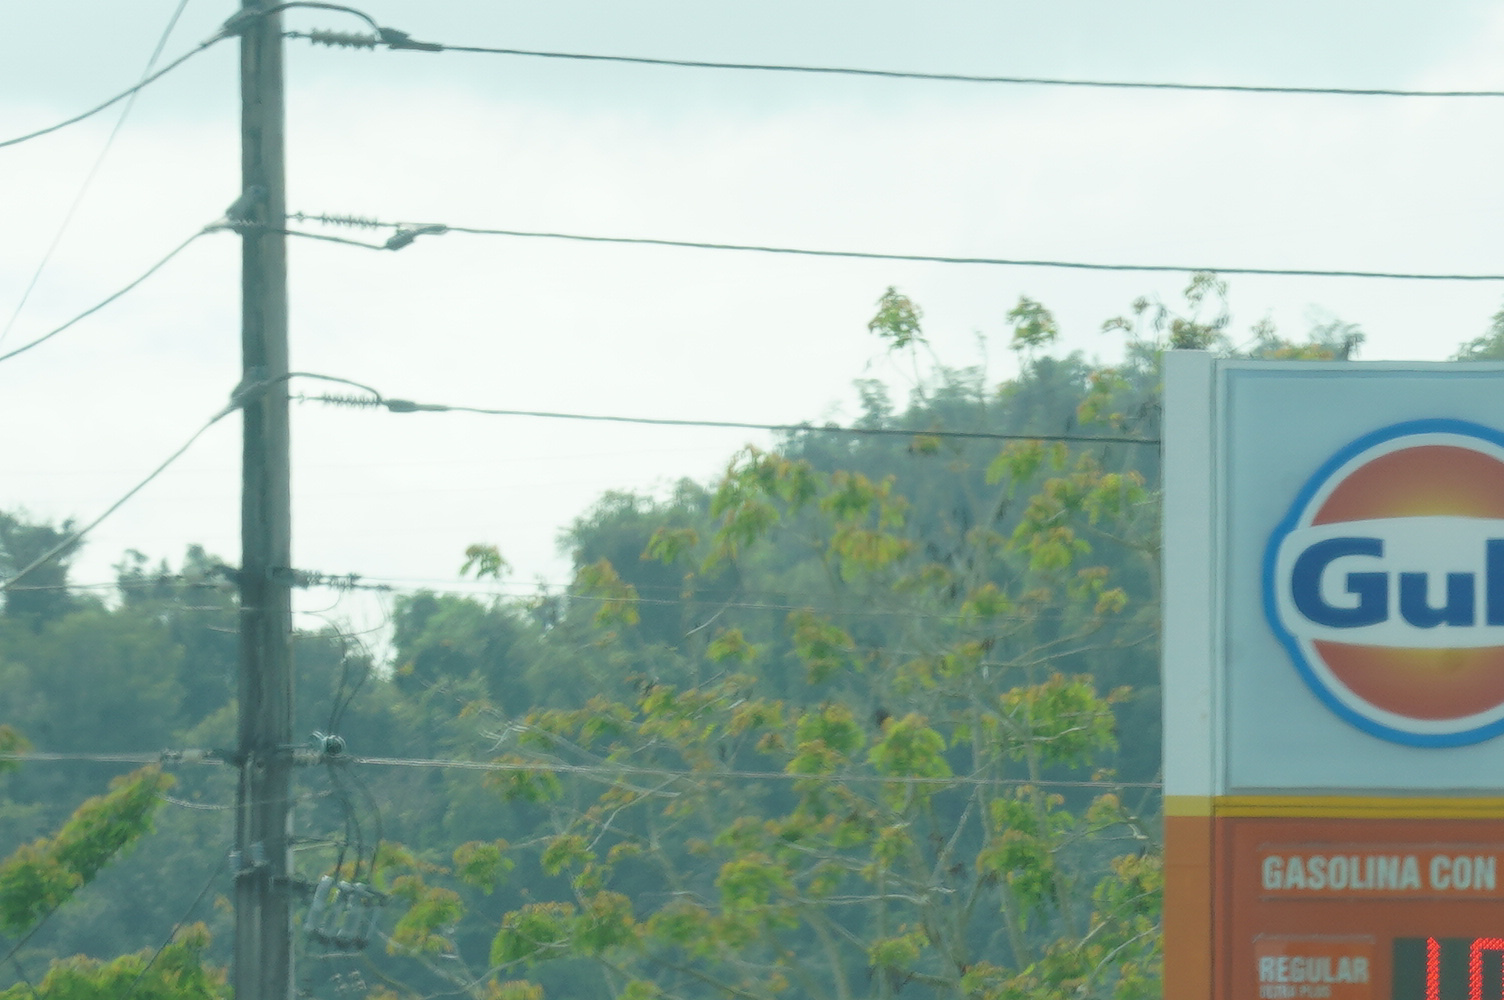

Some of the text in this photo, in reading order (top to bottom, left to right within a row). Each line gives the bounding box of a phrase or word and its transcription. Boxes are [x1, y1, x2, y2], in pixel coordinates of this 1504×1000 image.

[1261, 855, 1421, 890] GASOLINA
[1429, 856, 1497, 891] CON
[1259, 956, 1369, 983] REGULAR
